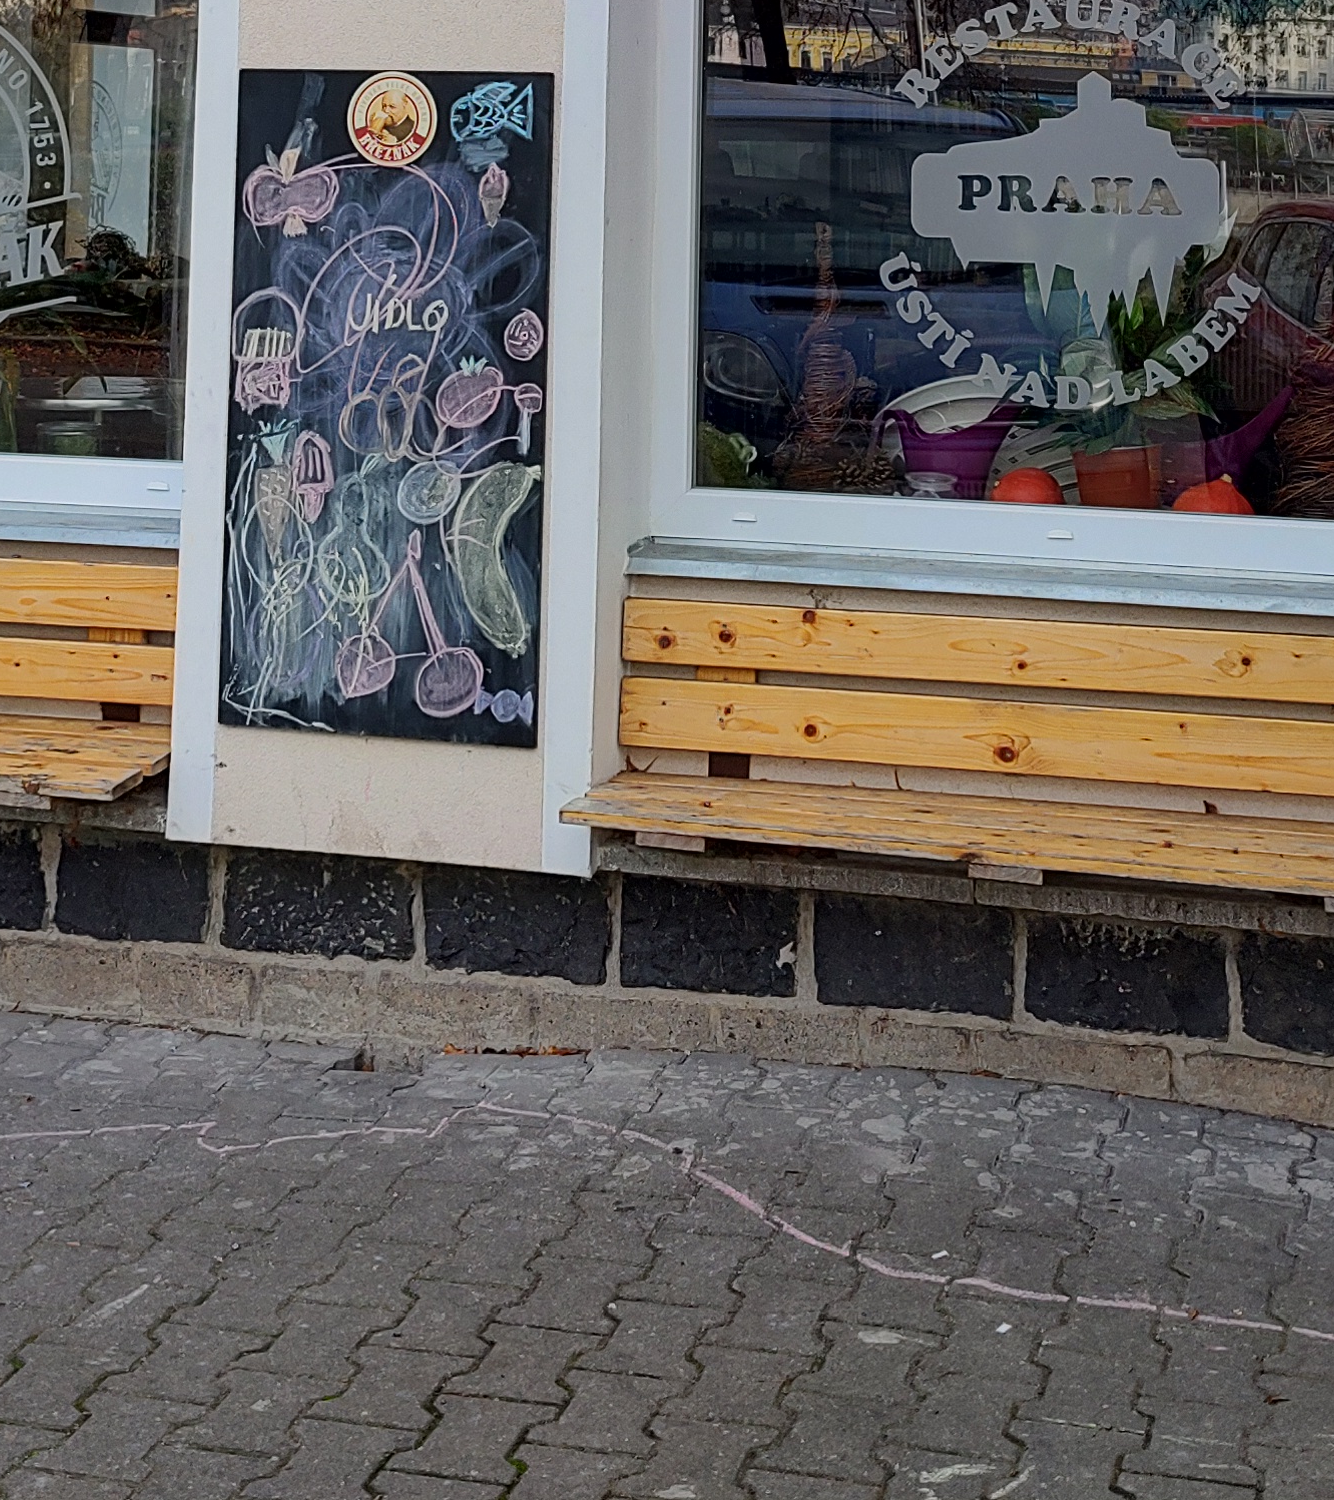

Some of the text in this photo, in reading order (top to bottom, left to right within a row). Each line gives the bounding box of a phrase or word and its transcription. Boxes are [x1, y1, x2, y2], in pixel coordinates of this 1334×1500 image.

[25, 97, 56, 167] 1753
[958, 175, 1182, 216] PRAHA
[879, 251, 1261, 411] ÚSTÍ NAD LABEM
